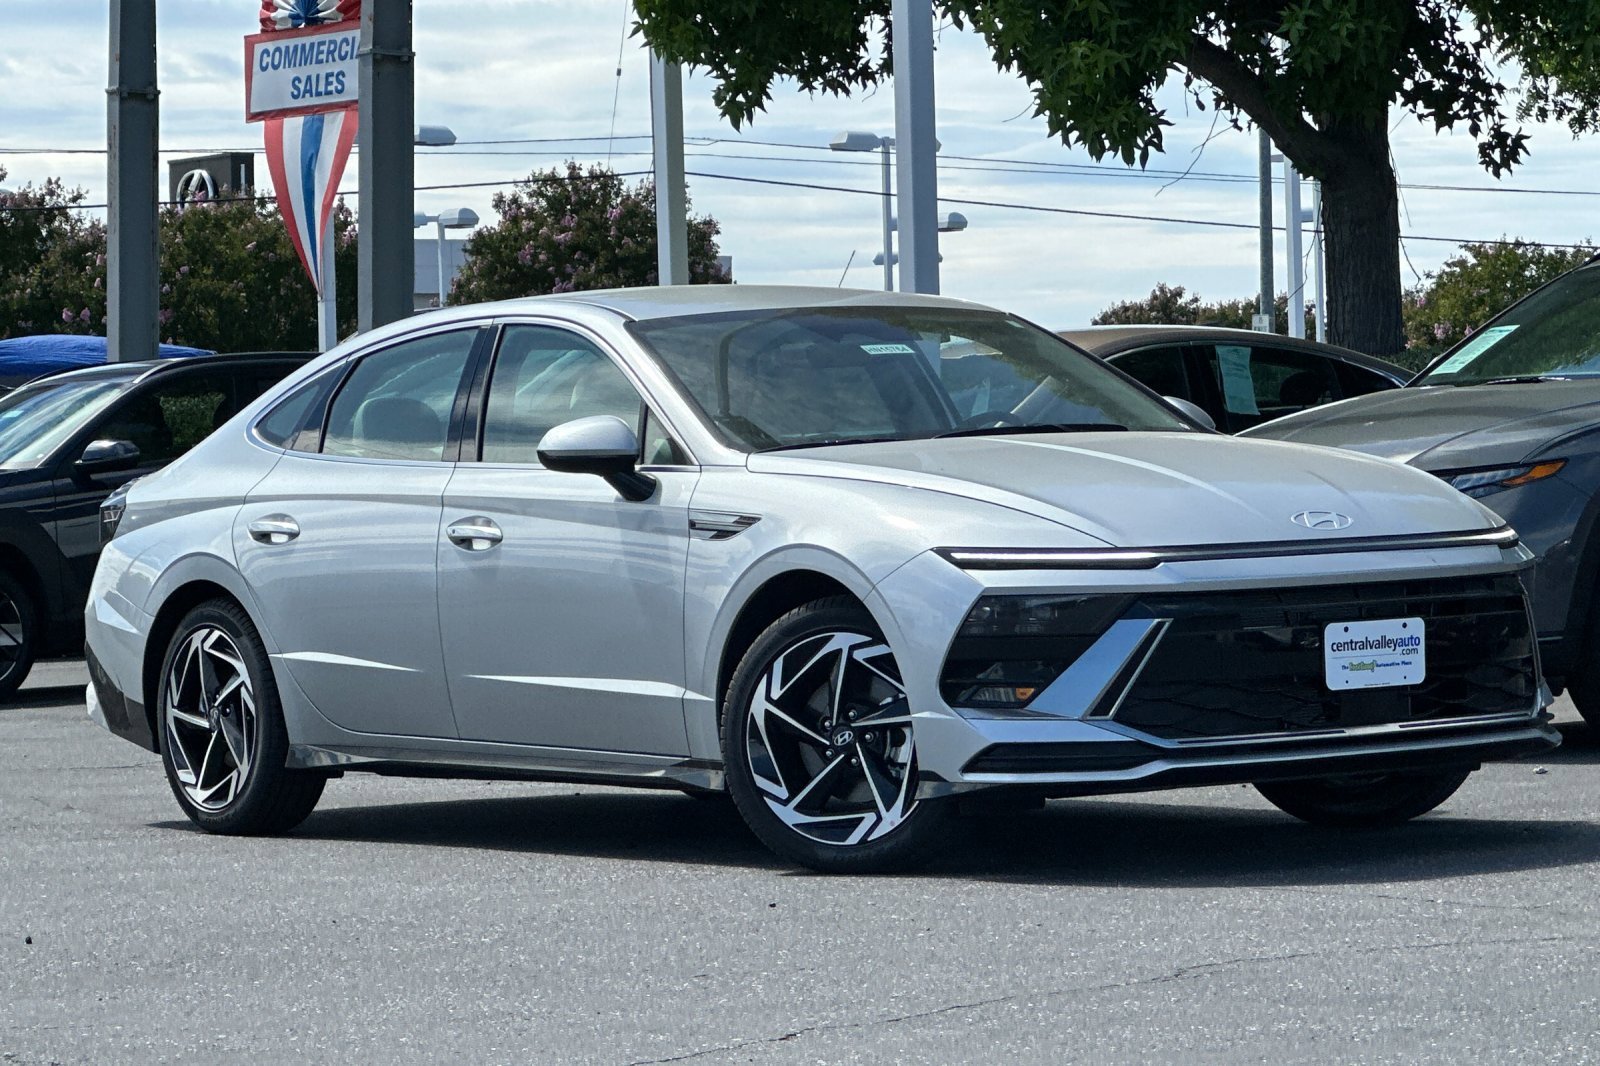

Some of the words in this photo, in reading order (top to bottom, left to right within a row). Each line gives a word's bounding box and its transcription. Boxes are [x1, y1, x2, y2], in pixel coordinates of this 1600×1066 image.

[290, 70, 346, 100] SALES
[1331, 635, 1420, 652] centralvalleyauto
[1400, 647, 1419, 656] .com
